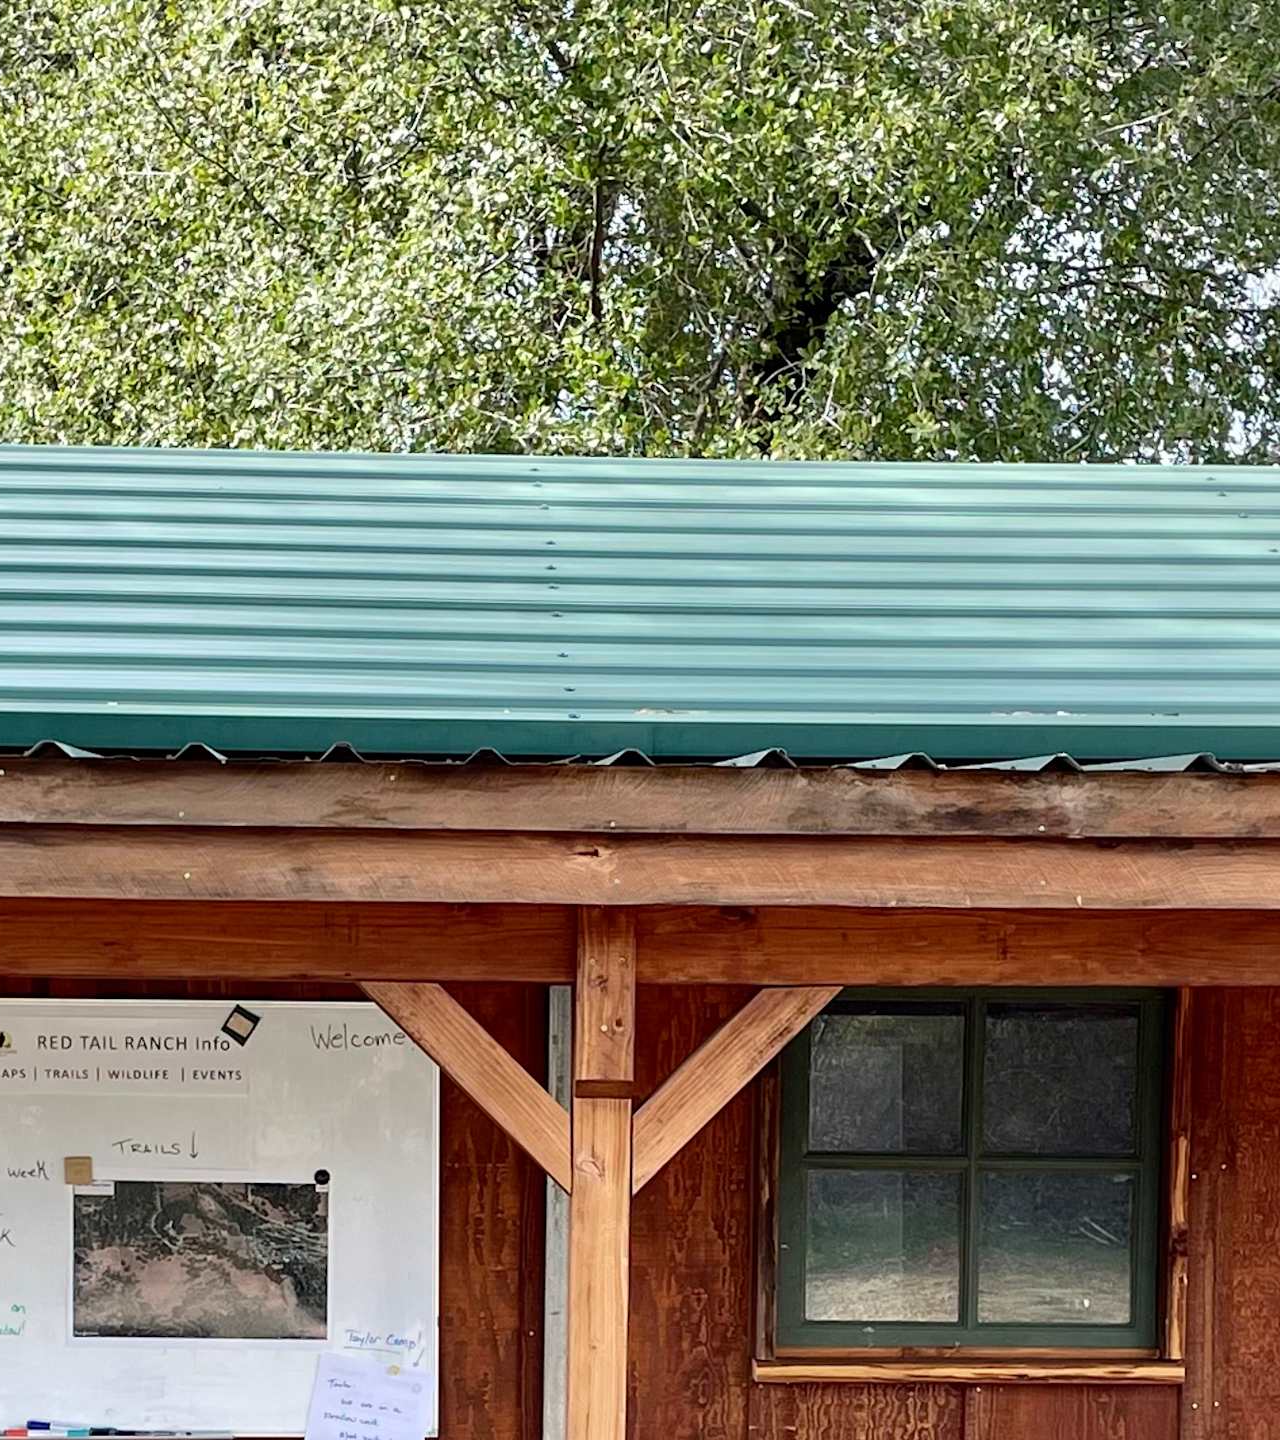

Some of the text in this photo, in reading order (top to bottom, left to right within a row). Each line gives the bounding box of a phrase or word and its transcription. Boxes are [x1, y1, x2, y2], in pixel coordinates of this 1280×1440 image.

[37, 1035, 231, 1052] RED TAIL RANCH Info
[309, 1023, 406, 1051] Welcome
[44, 1068, 89, 1080] TRAILS
[107, 1069, 170, 1081] WILDLIFE
[192, 1069, 243, 1081] EVENTS
[112, 1138, 182, 1156] TRAILS
[344, 1329, 382, 1348] Taylor
